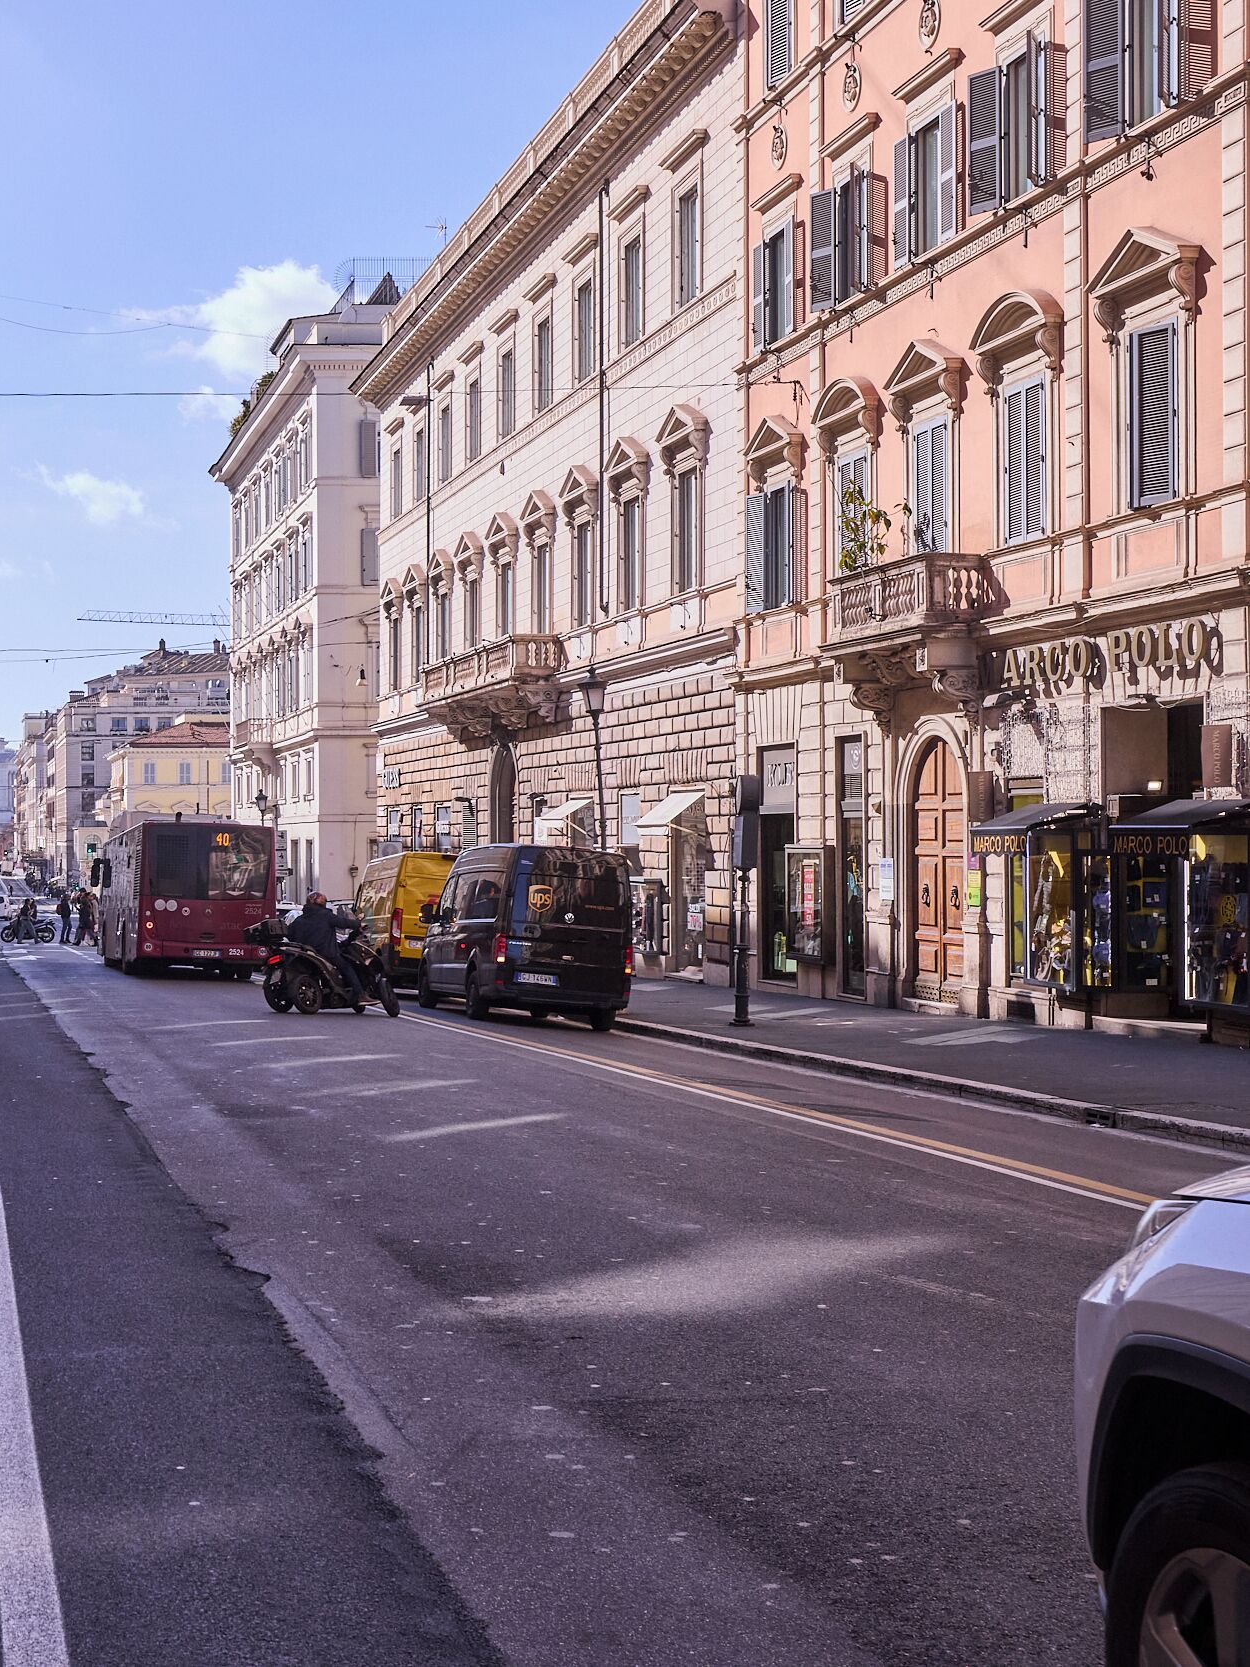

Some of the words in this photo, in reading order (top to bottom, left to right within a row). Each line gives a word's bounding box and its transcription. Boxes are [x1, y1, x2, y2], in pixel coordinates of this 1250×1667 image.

[1106, 618, 1209, 673] POLO
[1213, 729, 1222, 760] MARCO
[1213, 761, 1222, 785] POLO
[216, 832, 231, 847] 40
[973, 835, 1002, 853] MARCO
[1004, 834, 1027, 852] POLO
[1113, 835, 1152, 855] MARCO
[1157, 835, 1190, 855] POLO
[530, 891, 551, 908] ups
[228, 948, 244, 956] 2524
